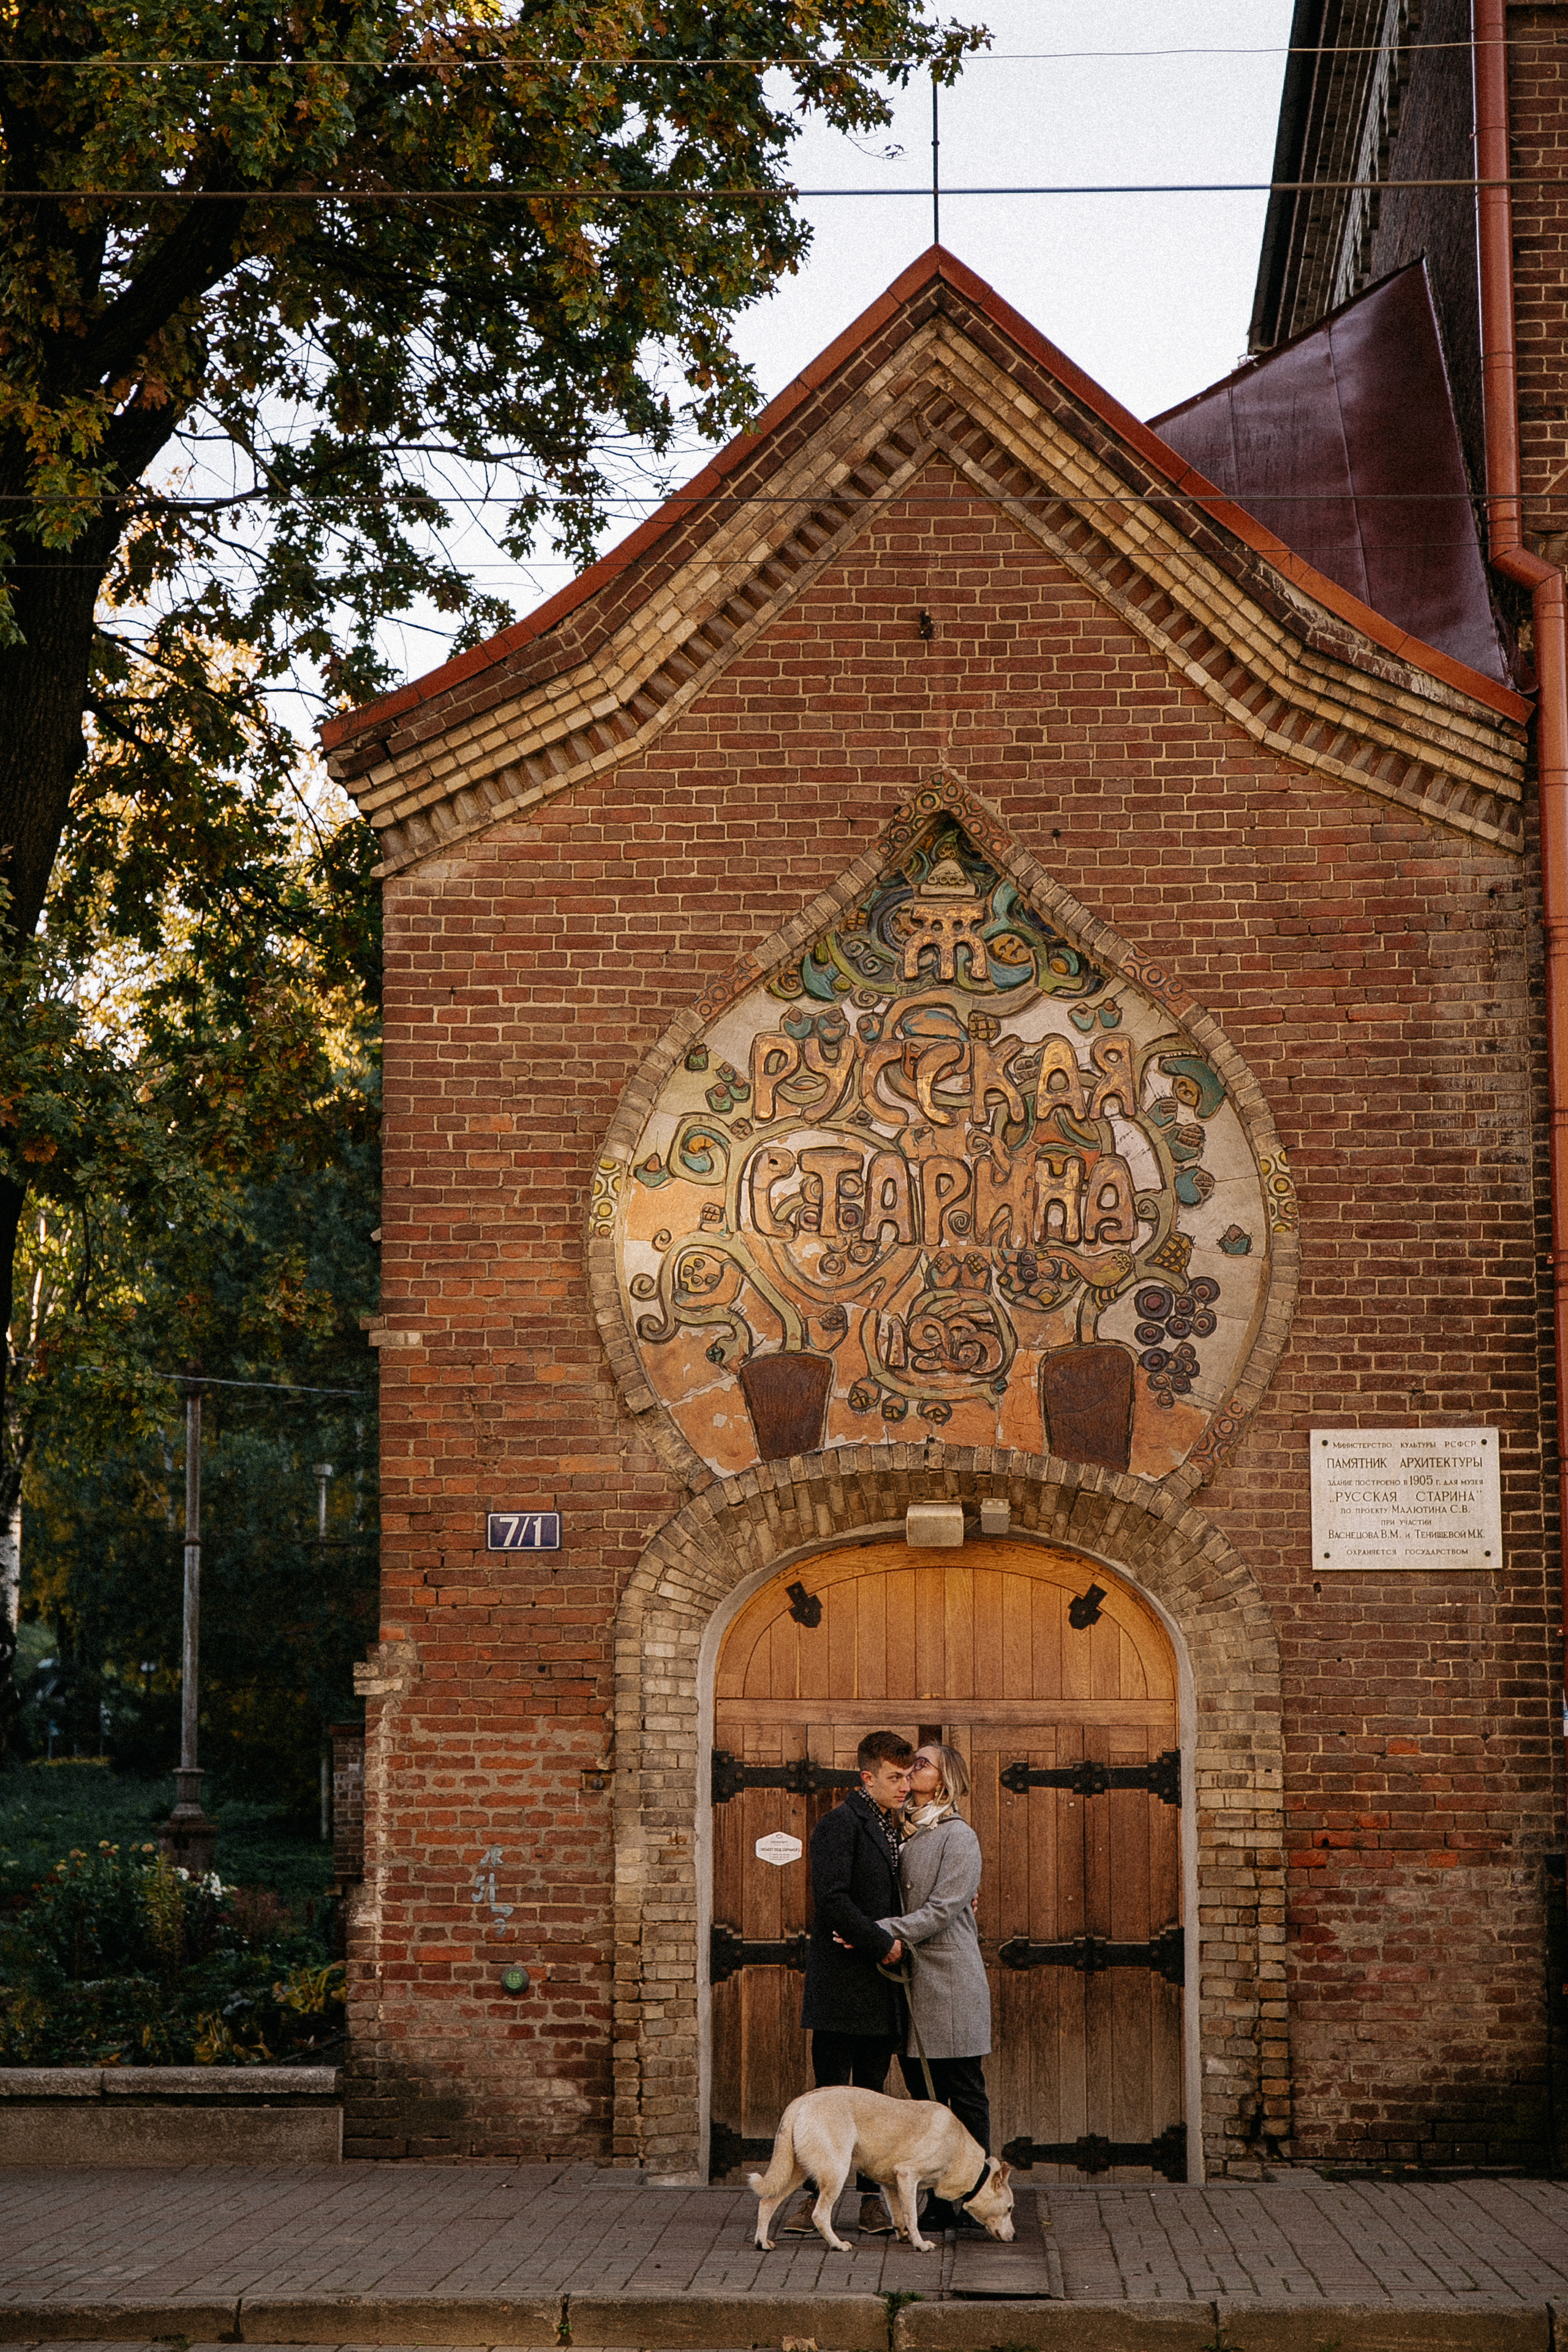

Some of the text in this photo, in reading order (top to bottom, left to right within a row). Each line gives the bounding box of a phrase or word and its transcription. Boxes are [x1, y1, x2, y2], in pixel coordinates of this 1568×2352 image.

[752, 1034, 1137, 1126] РУССКАЯ
[748, 1145, 1141, 1250] СТАРИНА
[1327, 1457, 1483, 1469] ПАМЯТНИК АРХИТЕКТУРЫ
[1409, 1475, 1433, 1486] 1905
[499, 1517, 542, 1547] 7/1
